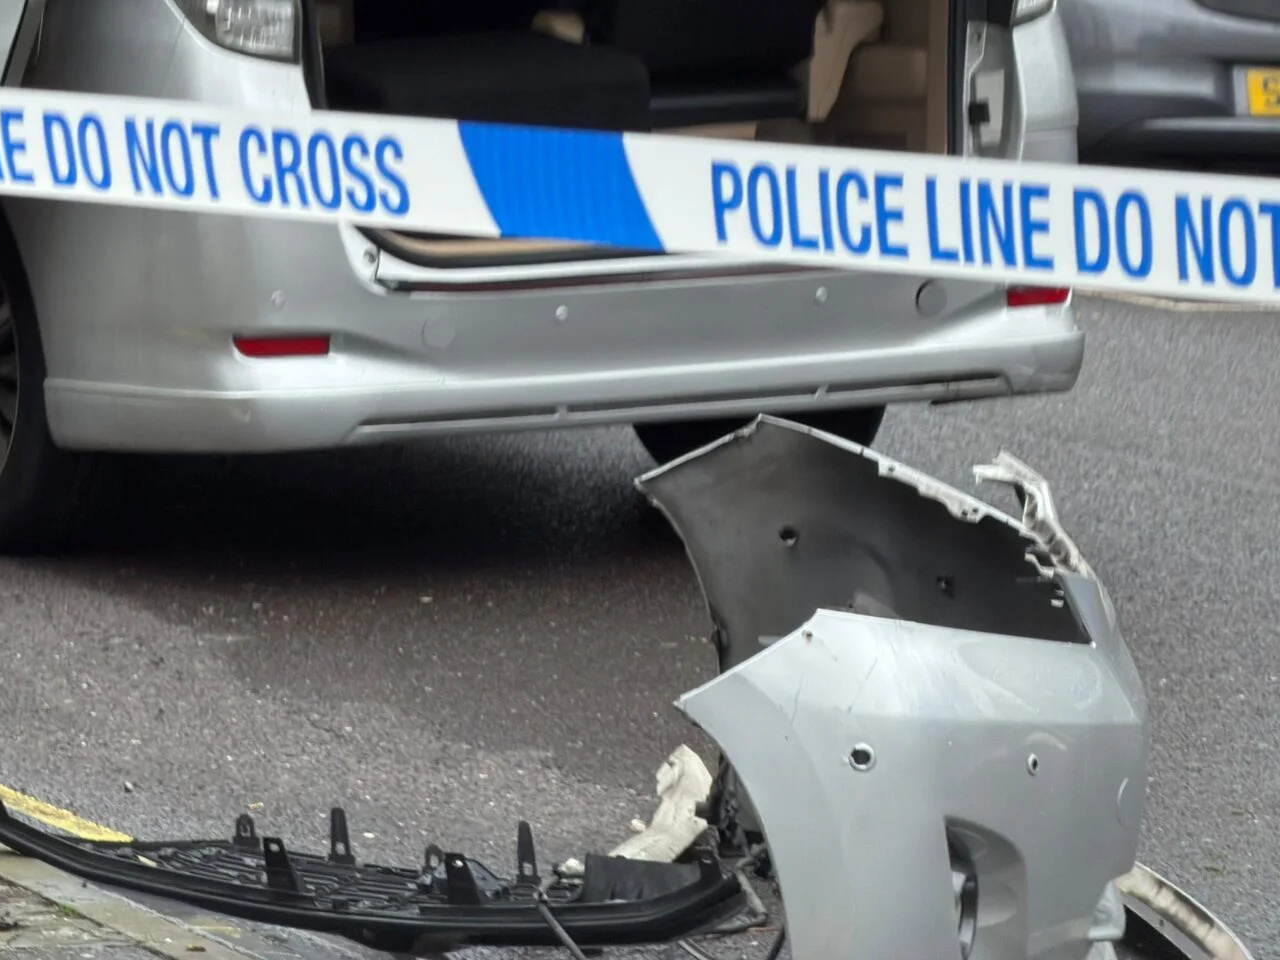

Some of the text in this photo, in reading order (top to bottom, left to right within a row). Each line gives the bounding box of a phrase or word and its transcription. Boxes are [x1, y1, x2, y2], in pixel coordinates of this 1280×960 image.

[42, 111, 113, 192] DO
[124, 117, 221, 202] NOT
[239, 125, 410, 219] CROSS
[711, 160, 1280, 290] POLICE LINE DO NOT
